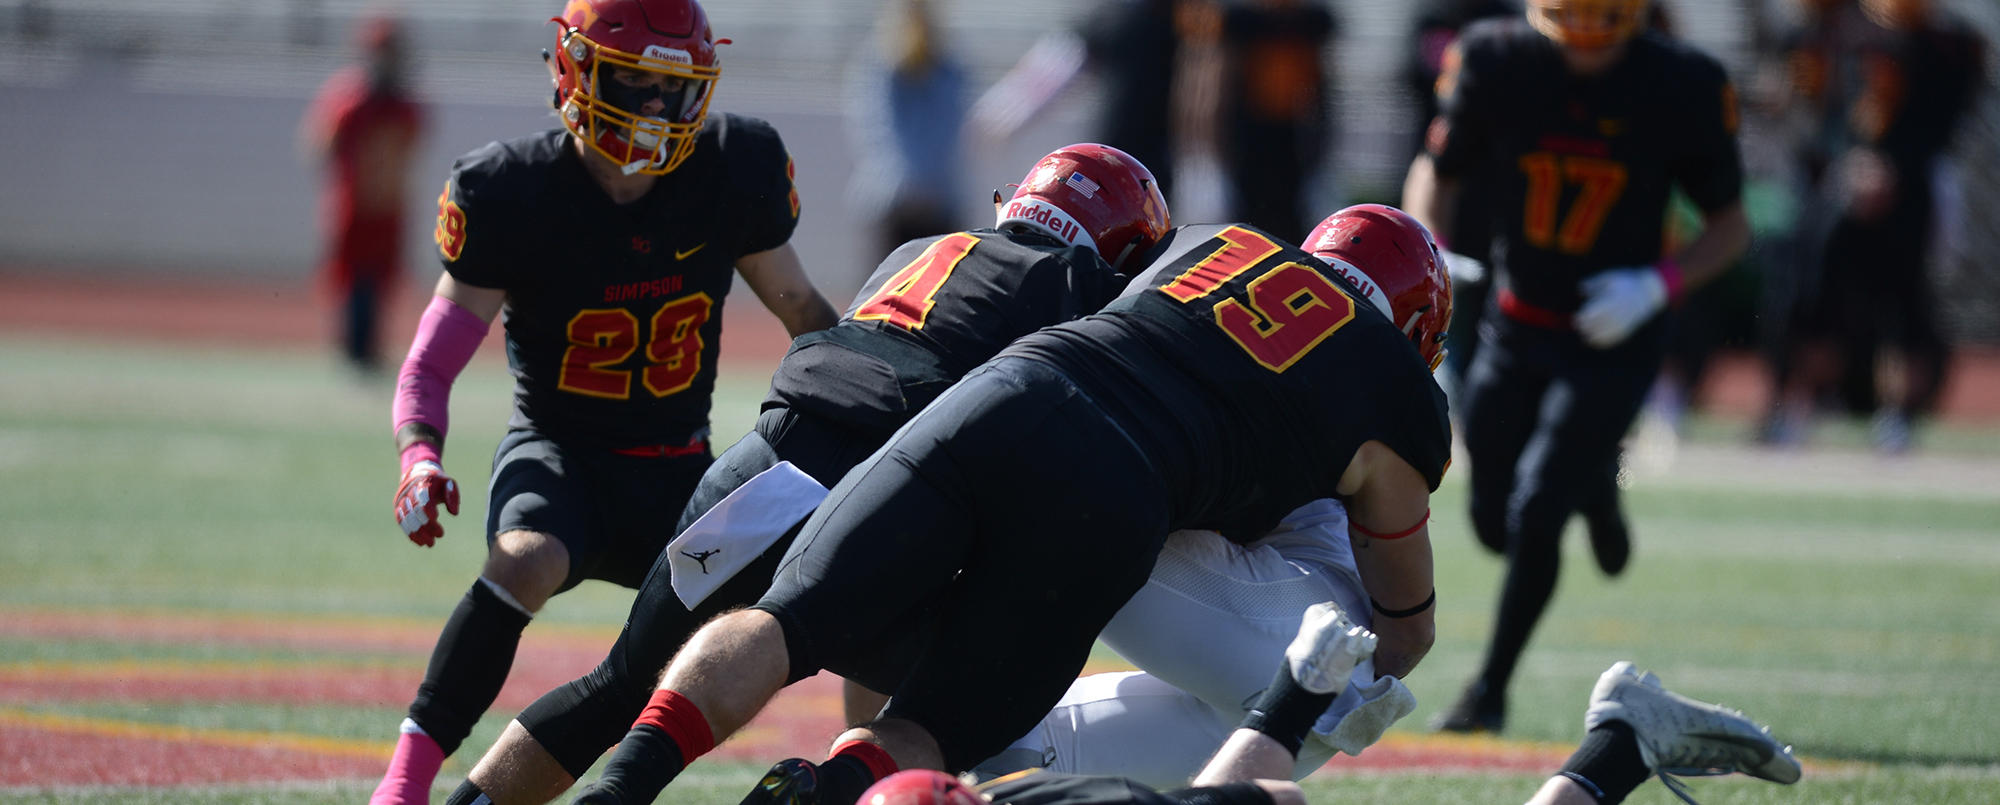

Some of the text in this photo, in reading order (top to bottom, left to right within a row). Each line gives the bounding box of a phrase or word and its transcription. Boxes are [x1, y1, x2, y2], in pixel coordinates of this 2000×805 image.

[1006, 202, 1079, 243] Riddell
[1518, 152, 1628, 253] 17
[604, 274, 683, 303] SIMPSON
[853, 231, 981, 332] 4
[1159, 225, 1356, 375] 19
[558, 291, 713, 399] 29
